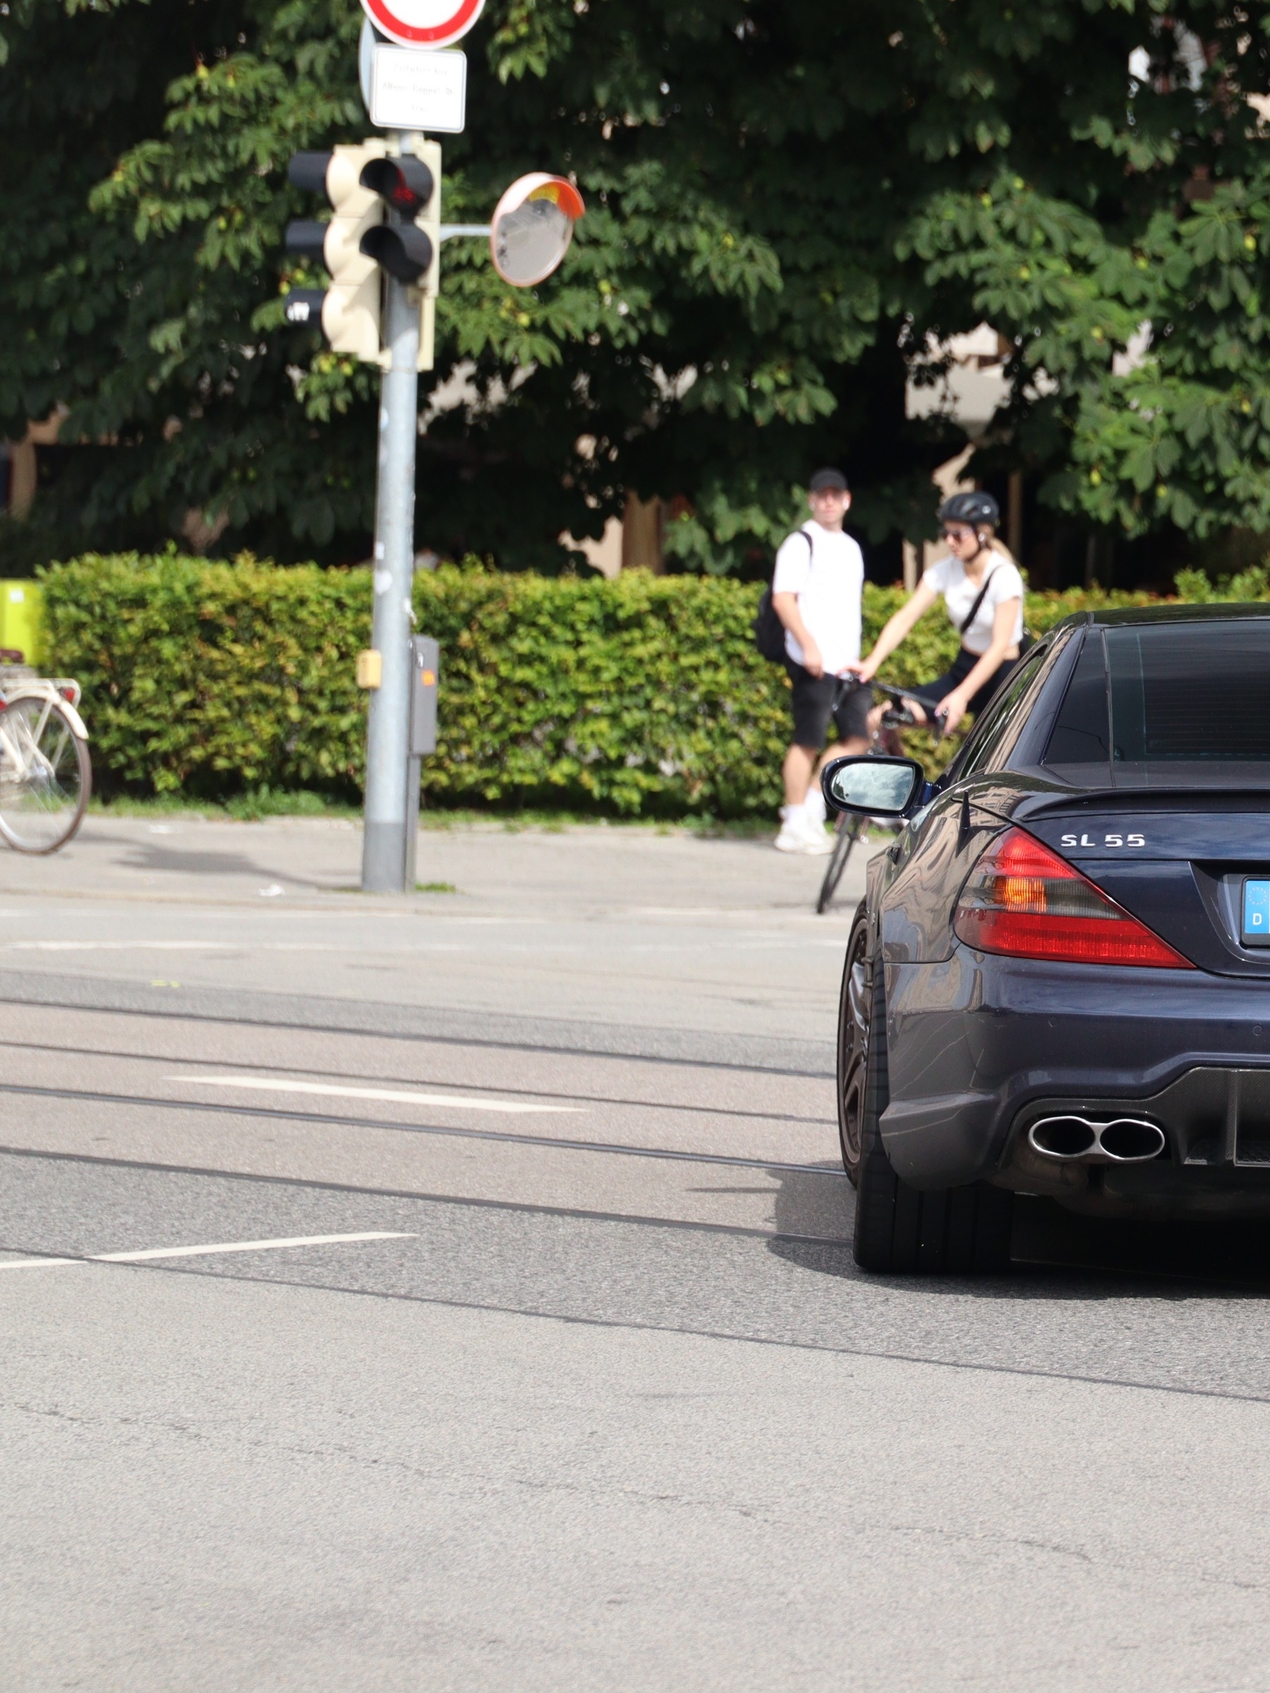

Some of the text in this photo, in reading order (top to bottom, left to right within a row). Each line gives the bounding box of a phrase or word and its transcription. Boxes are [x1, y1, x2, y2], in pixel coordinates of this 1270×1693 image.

[1060, 833, 1146, 847] SL 55
[1252, 912, 1263, 926] D
